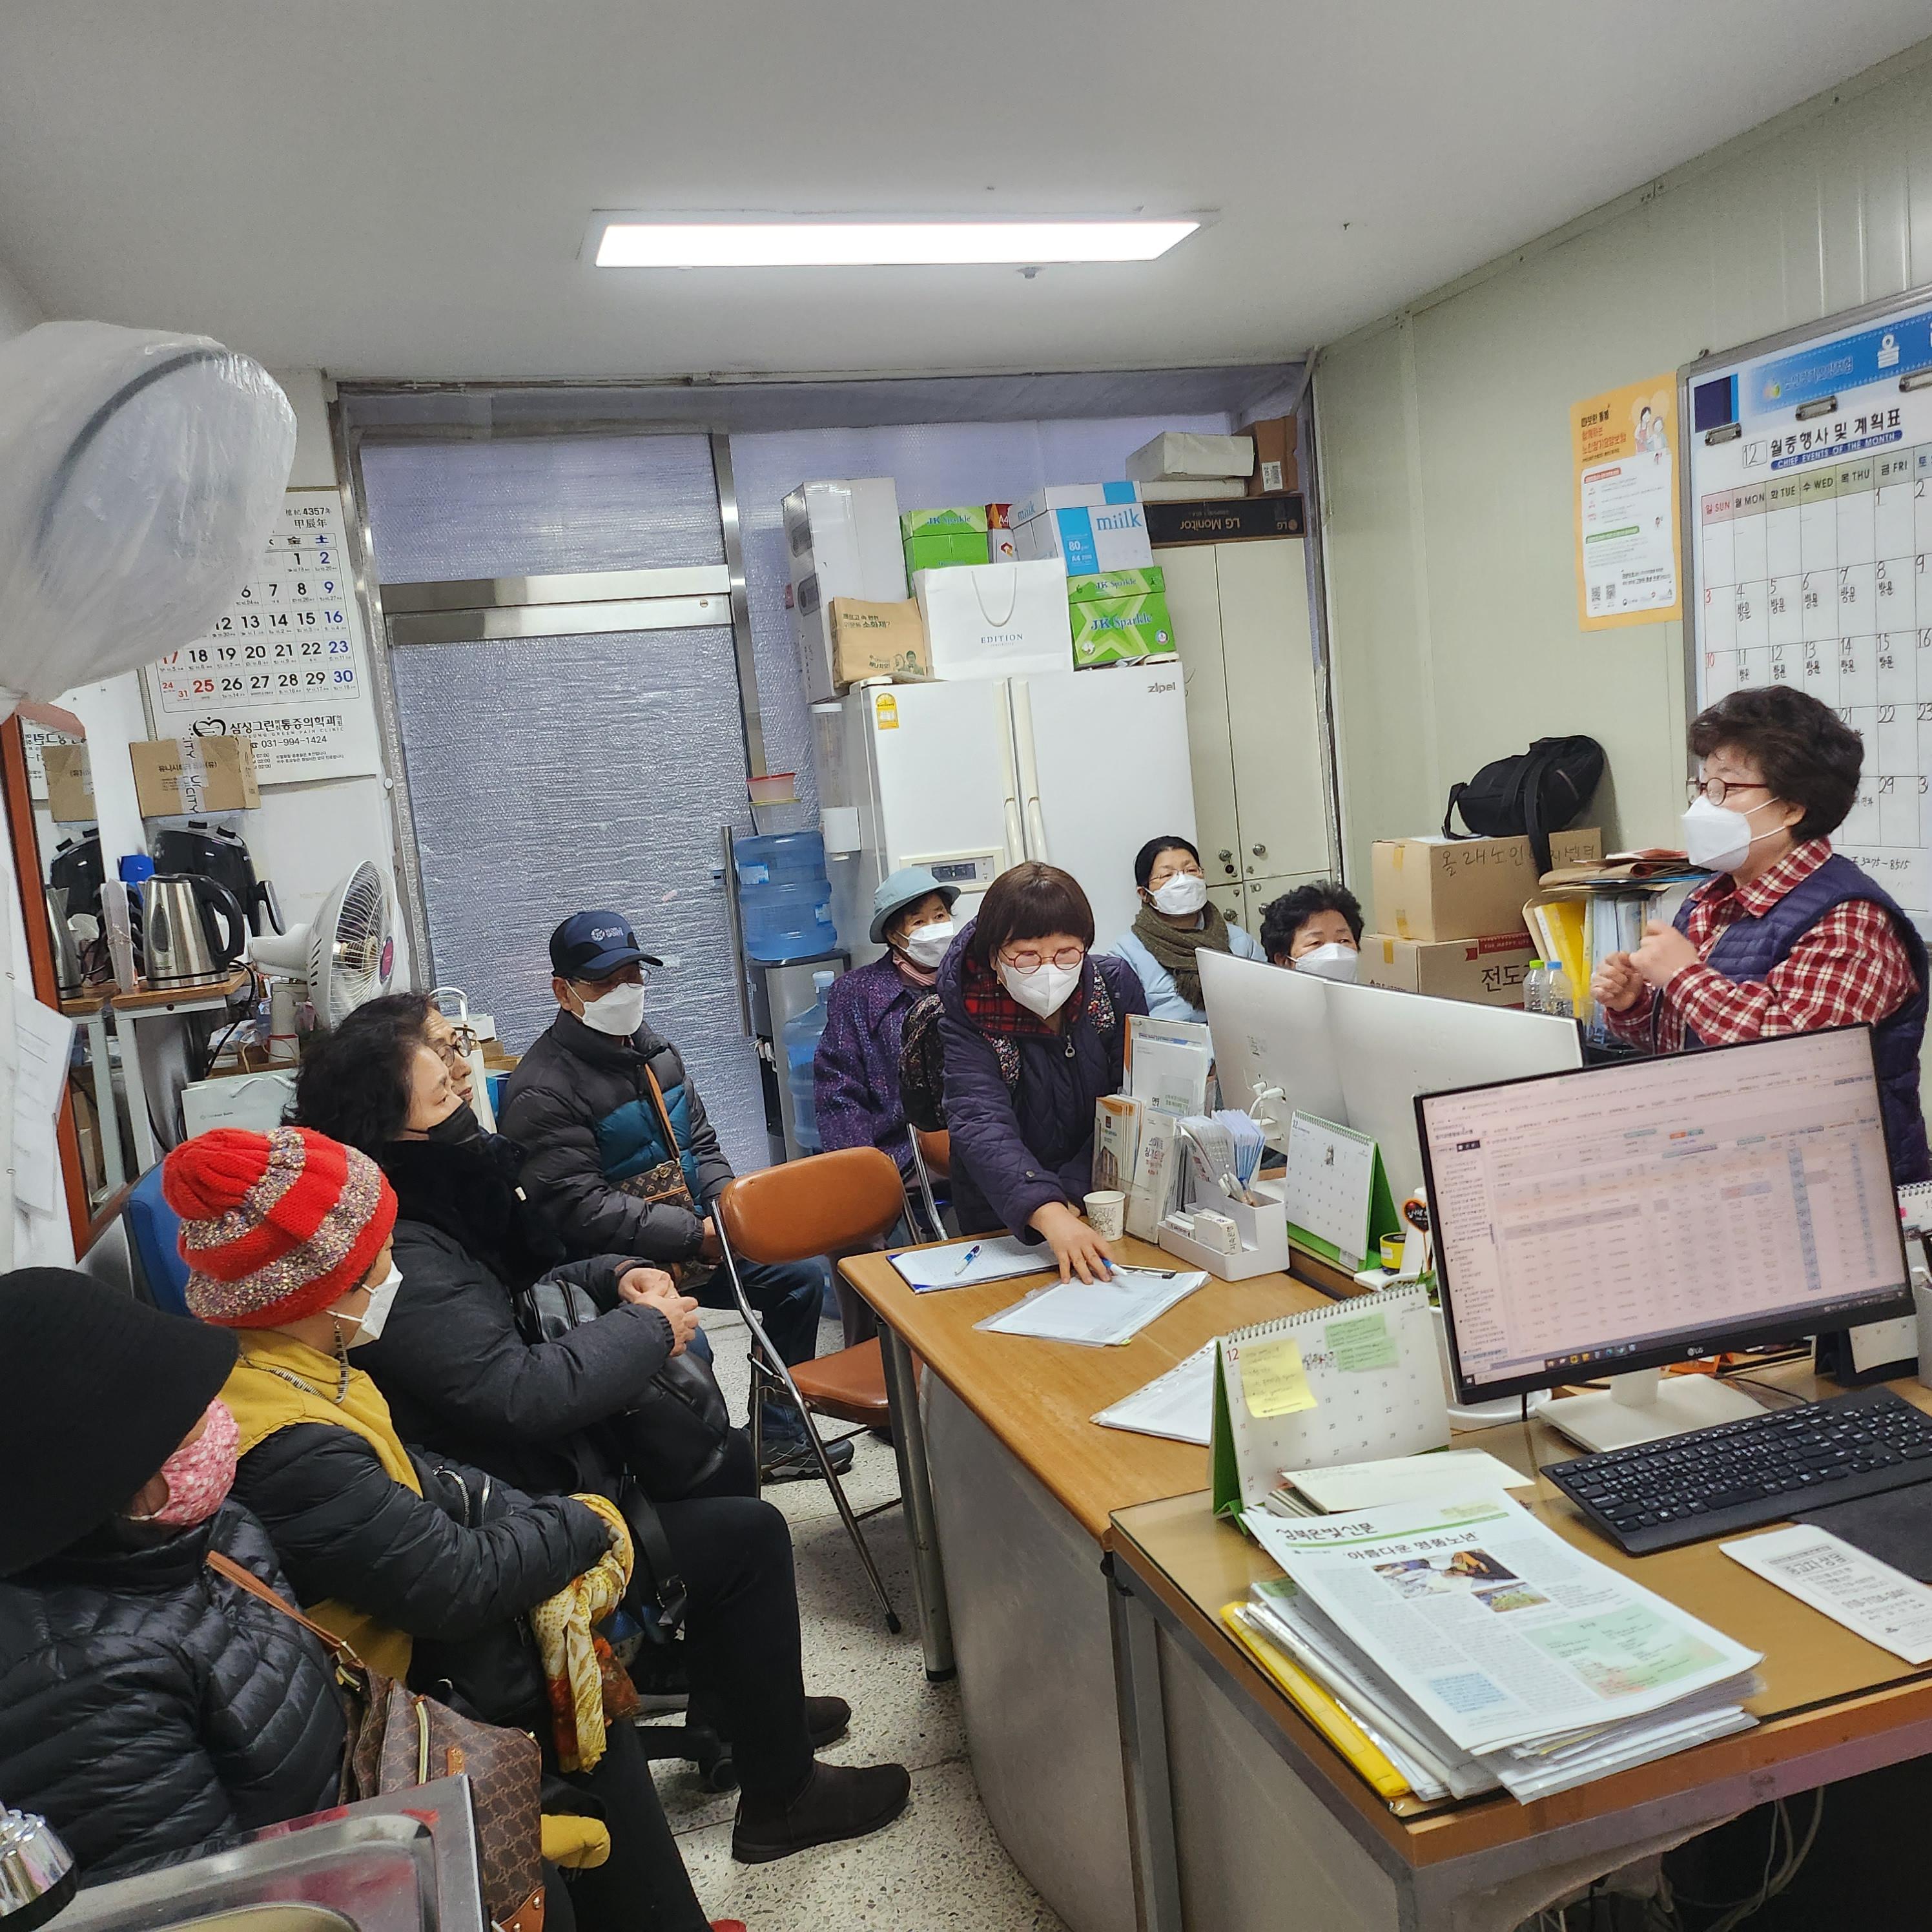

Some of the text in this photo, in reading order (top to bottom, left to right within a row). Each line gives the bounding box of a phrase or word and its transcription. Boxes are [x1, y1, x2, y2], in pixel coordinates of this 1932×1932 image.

[1771, 408, 1901, 458] 월중행사 및 계획표
[1743, 444, 1758, 465] 12
[1778, 433, 1895, 468] CHIEF EVENTS OF THE MONTH
[1881, 460, 1907, 475] 금 FRI
[1918, 456, 1927, 467] 토
[1842, 469, 1870, 483] 목 THU
[1803, 478, 1833, 492] 수 WED
[1915, 480, 1925, 498] 2
[1771, 486, 1795, 500] 화 TUE
[1735, 493, 1765, 508] 월 MON
[1018, 501, 1036, 520] miilk
[1705, 501, 1730, 515] 일 SUN
[999, 515, 1009, 524] A4
[1097, 508, 1142, 531] miilk
[1180, 518, 1240, 531] LG Monitor
[1277, 522, 1287, 530] LG
[315, 535, 329, 544] 土
[294, 553, 301, 565] 1
[320, 551, 331, 564] 2
[1916, 555, 1925, 573] 9
[1840, 566, 1849, 584] 7
[1876, 560, 1885, 579] 8
[324, 581, 334, 594] 9
[1110, 579, 1137, 589] Sparkle
[1770, 579, 1777, 594] 5
[1802, 572, 1810, 590] 6
[241, 585, 251, 598] 6
[269, 583, 278, 597] 7
[297, 582, 307, 595] 8
[1705, 588, 1712, 603] 3
[1737, 583, 1745, 599] 4
[241, 615, 260, 628] 13
[269, 614, 288, 627] 14
[296, 612, 316, 625] 15
[324, 610, 344, 624] 16
[1091, 612, 1153, 631] JK Sparkle
[981, 633, 1023, 644] EDITION
[1877, 633, 1889, 652] 15
[1918, 628, 1931, 648] 16
[245, 646, 266, 659] 20
[274, 644, 293, 657] 21
[301, 642, 322, 655] 22
[328, 641, 349, 653] 23
[1805, 641, 1816, 659] 13
[1840, 637, 1851, 655] 14
[189, 650, 208, 663] 18
[217, 647, 236, 661] 19
[1706, 652, 1715, 667] 10
[1737, 648, 1746, 665] 11
[1771, 646, 1782, 663] 12
[250, 675, 270, 689] 27
[278, 673, 299, 687] 28
[305, 672, 325, 685] 29
[333, 670, 353, 683] 30
[192, 679, 214, 694] 25
[221, 678, 243, 692] 26
[1877, 704, 1895, 724] 22
[262, 735, 327, 748] 031-994-1424
[1878, 776, 1894, 794] 29
[1226, 1348, 1239, 1362] 12
